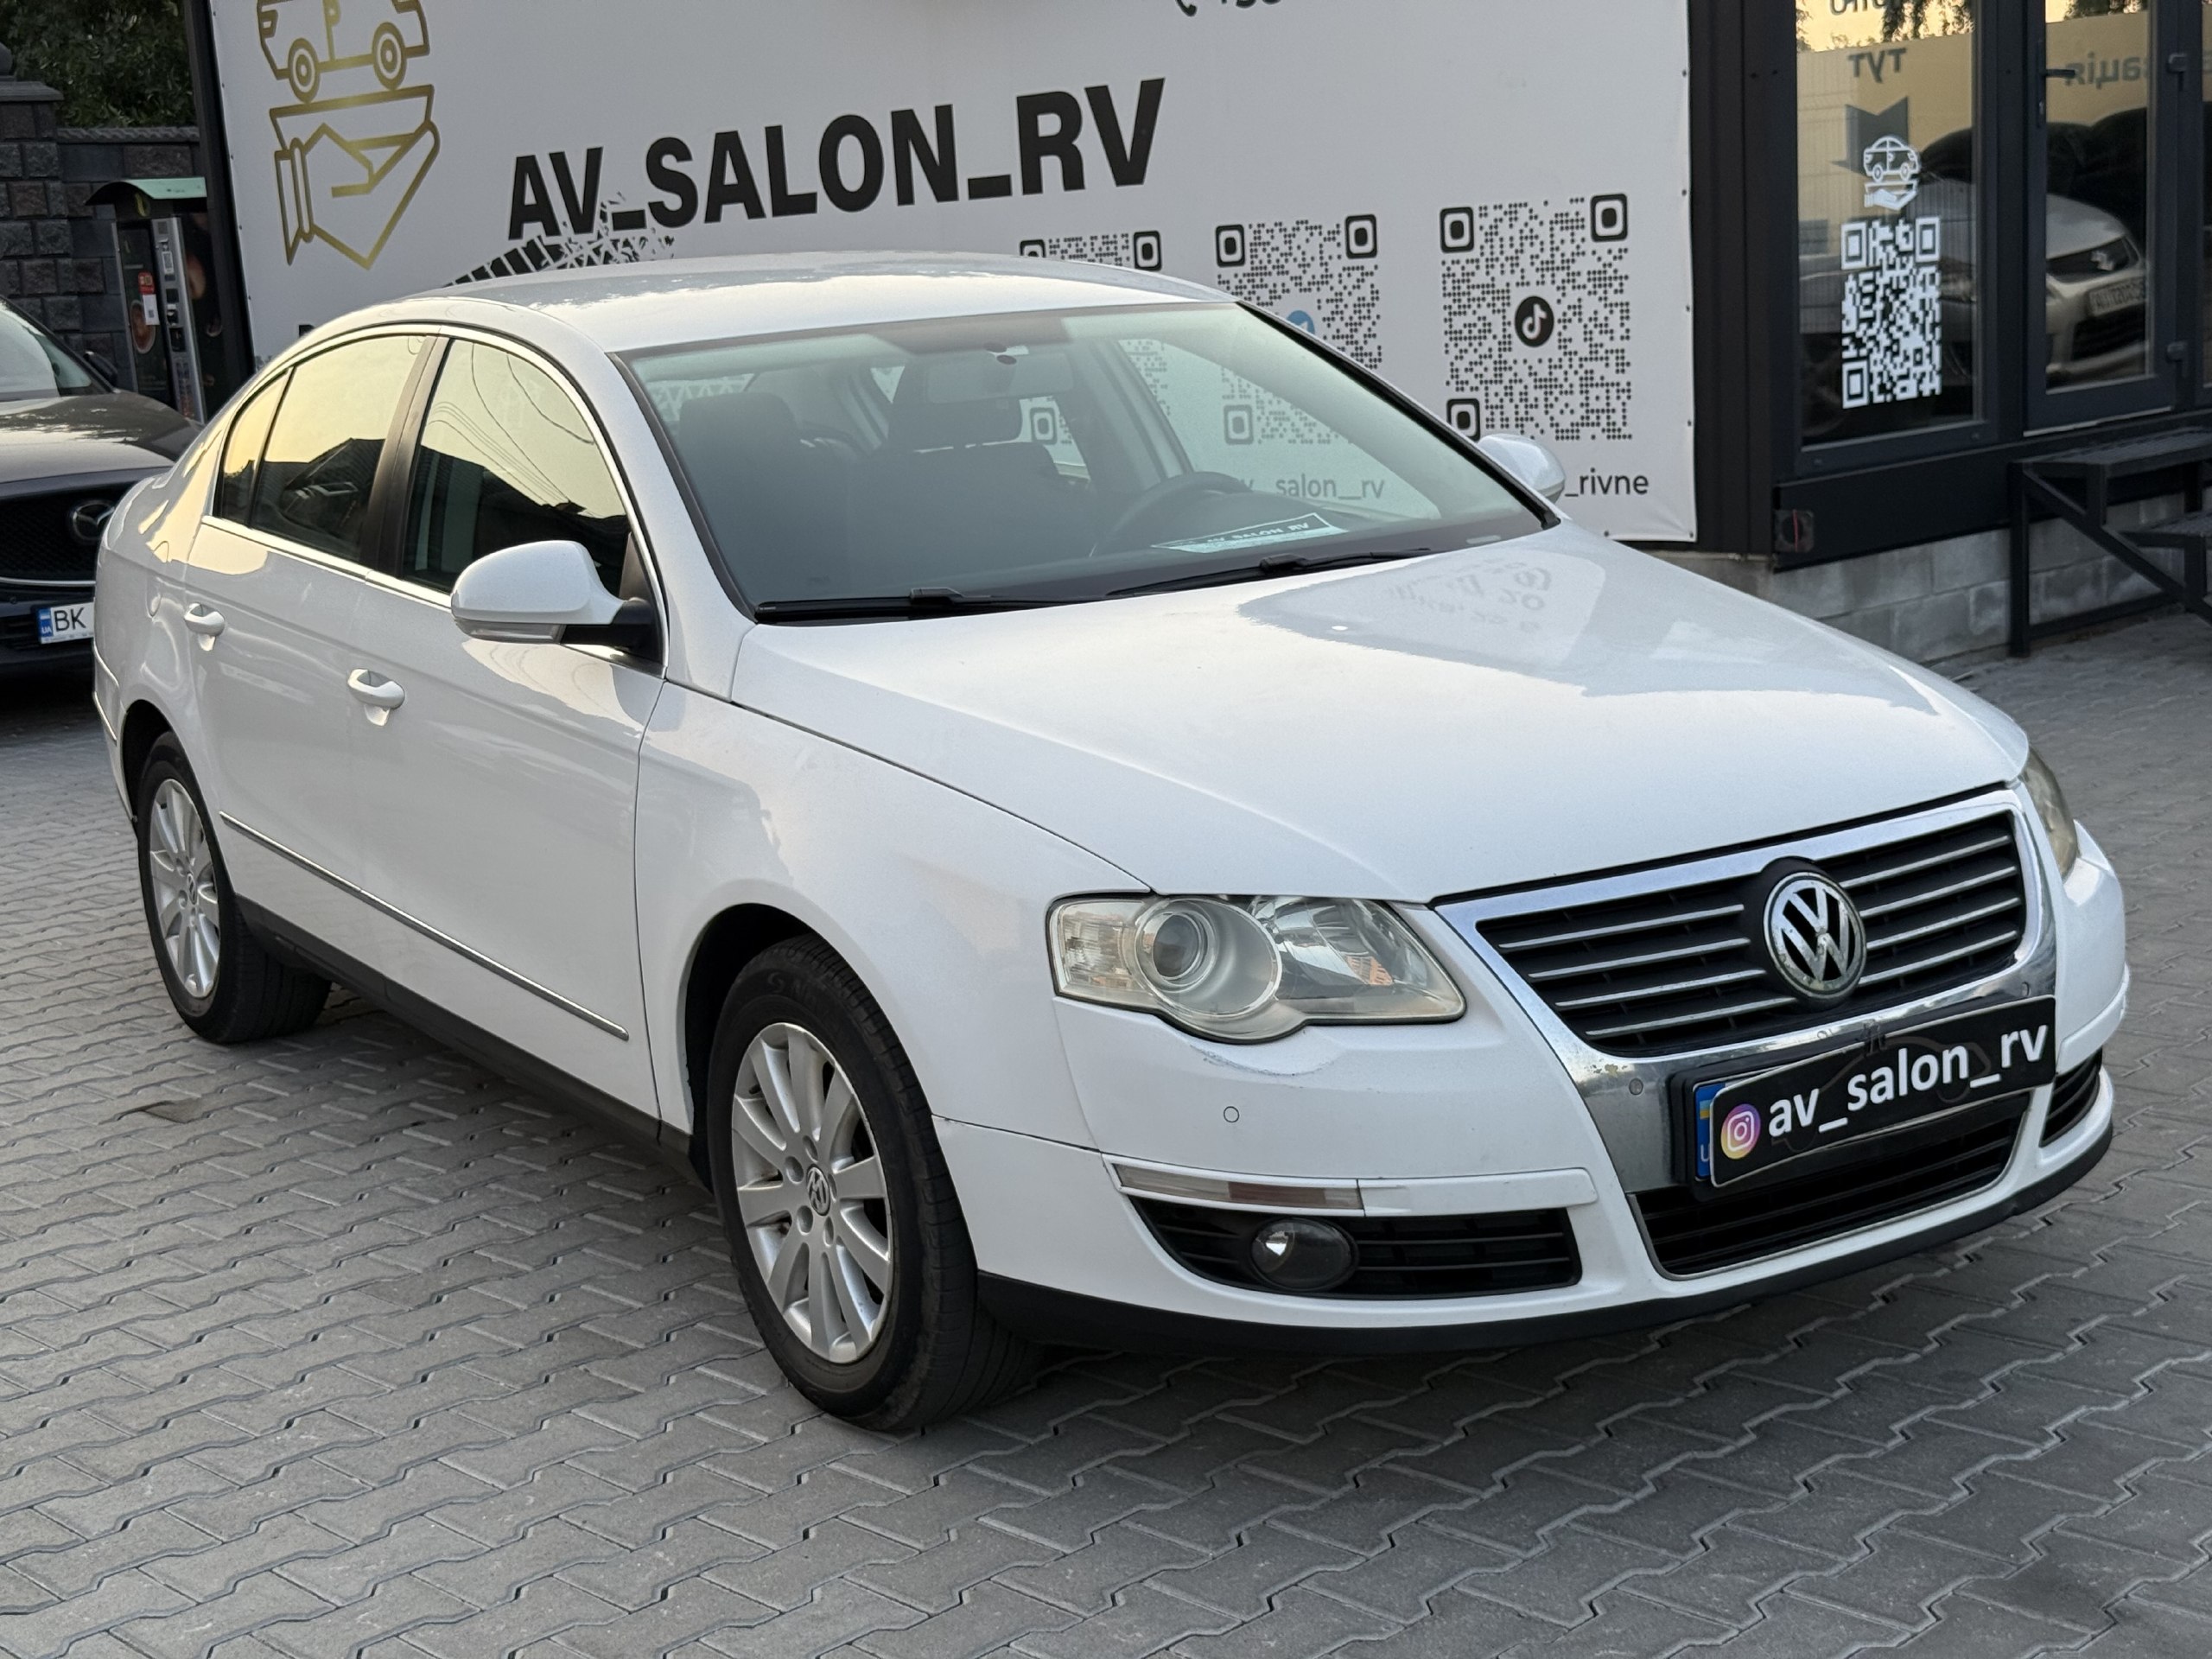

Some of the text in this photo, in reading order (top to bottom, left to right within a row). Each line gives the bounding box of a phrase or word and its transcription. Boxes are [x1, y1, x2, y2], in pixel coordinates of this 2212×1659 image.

[508, 78, 1166, 241] AV_SALON_RV
[54, 607, 86, 632] BK
[1768, 1025, 2049, 1137] av_salon_rv
